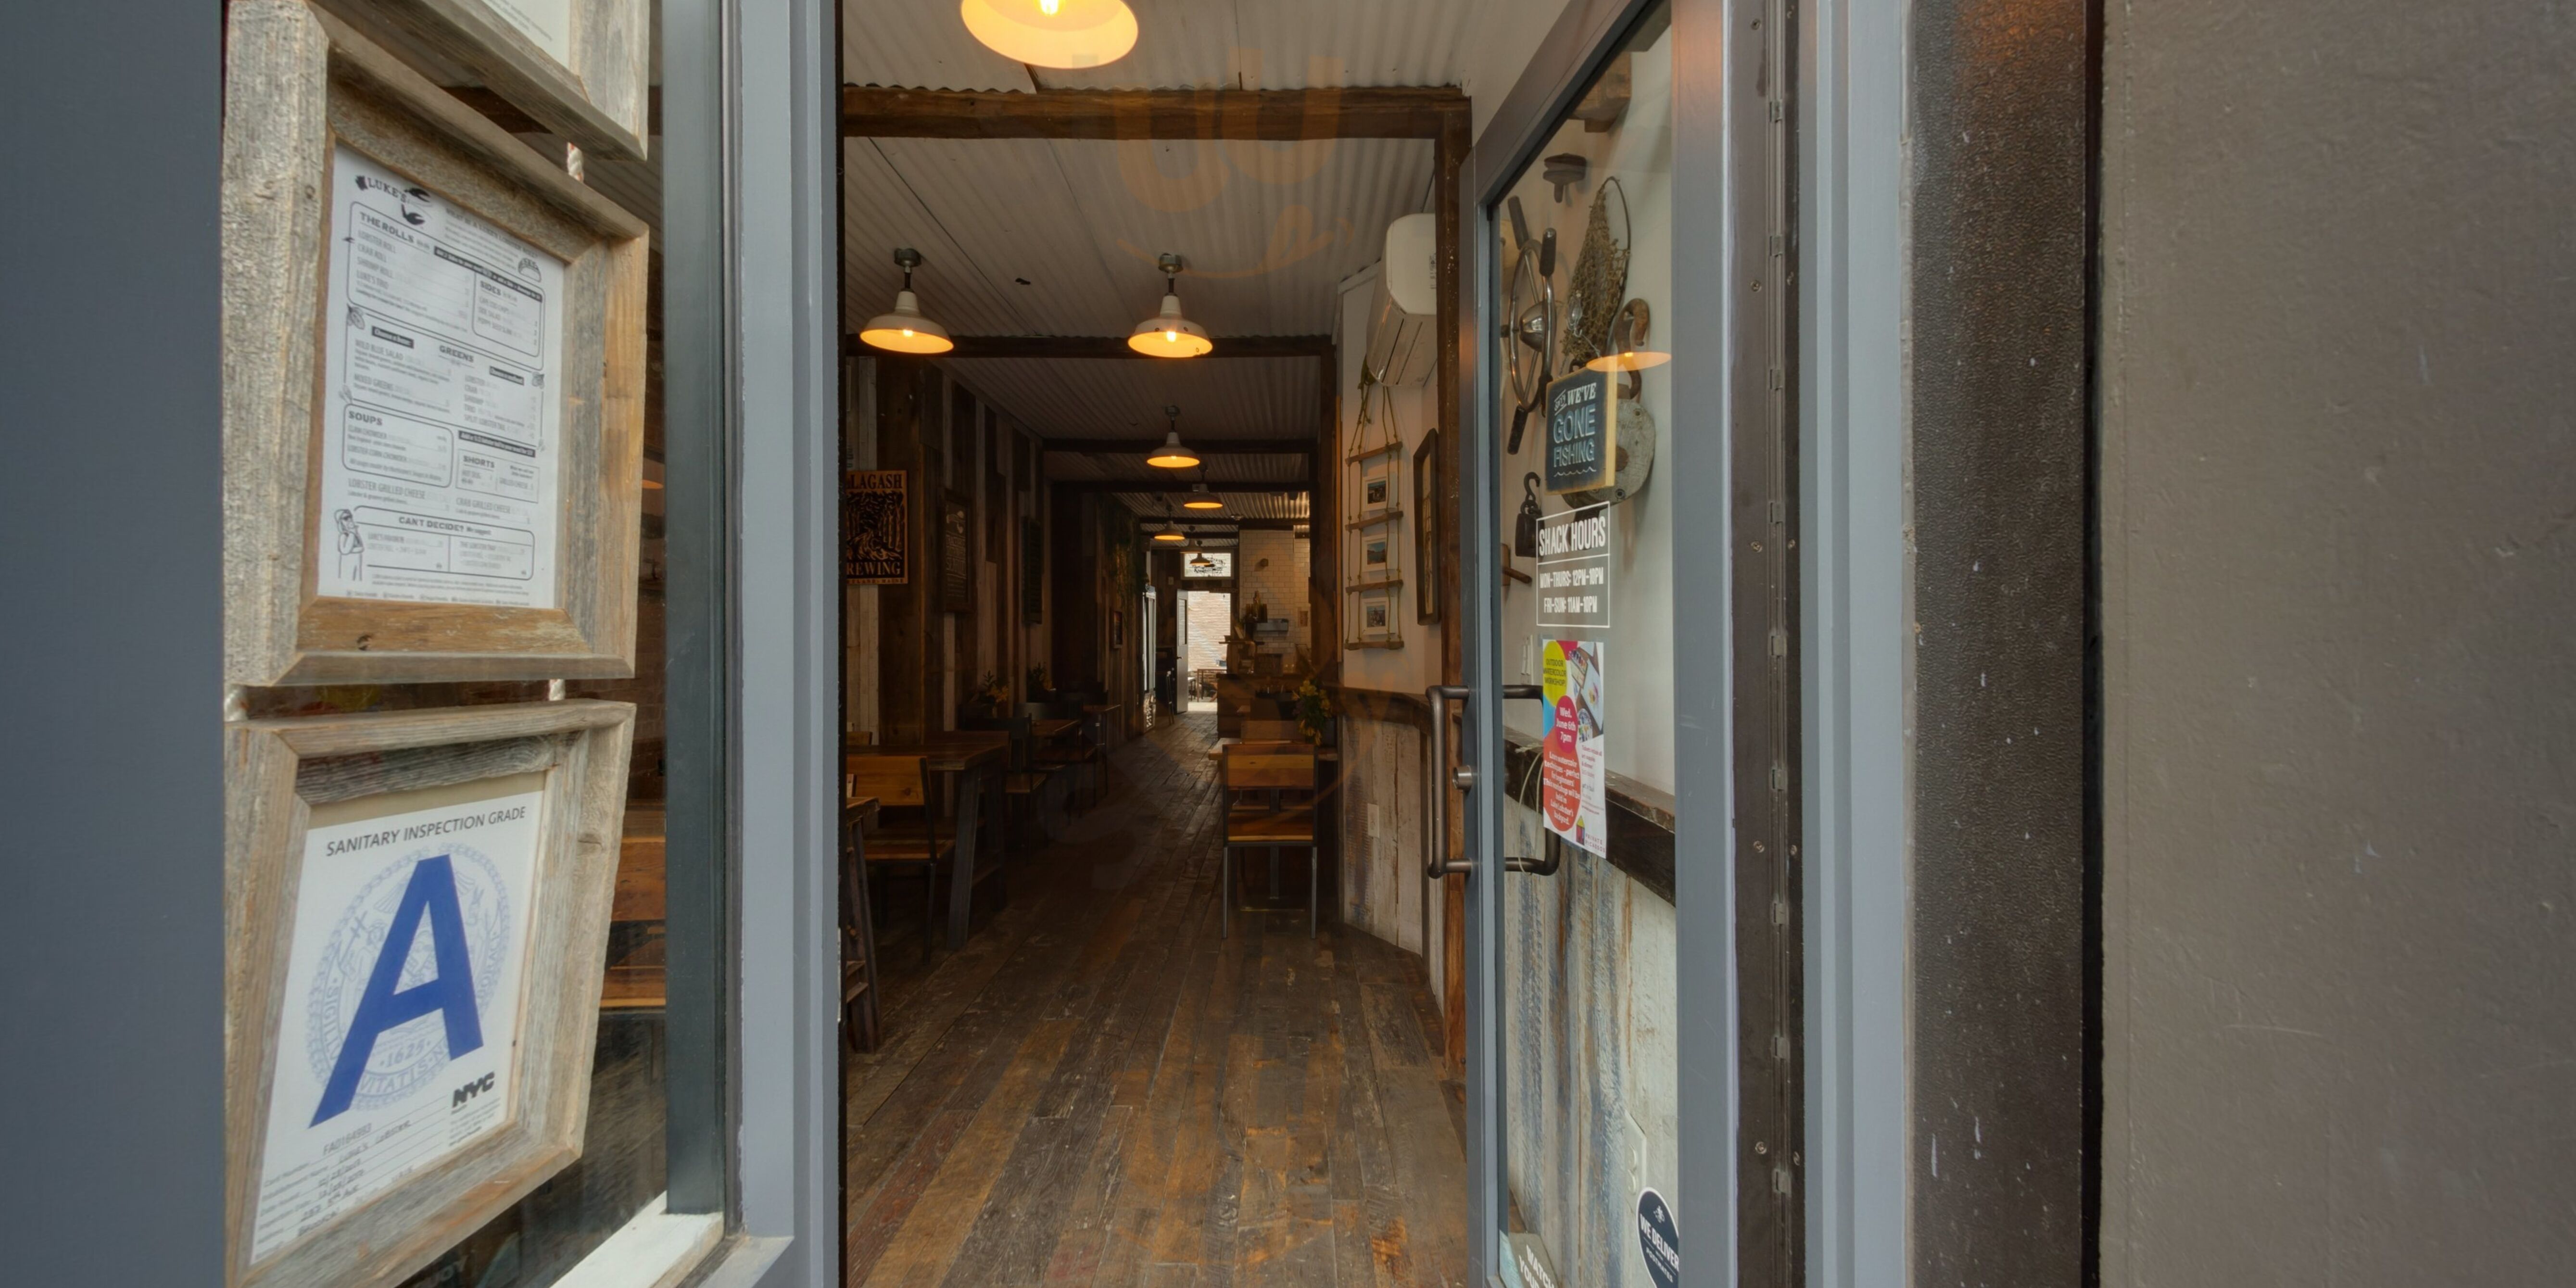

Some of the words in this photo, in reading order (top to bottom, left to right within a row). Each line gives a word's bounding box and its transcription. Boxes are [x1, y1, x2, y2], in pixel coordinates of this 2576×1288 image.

[367, 177, 407, 203] LUKE'S
[359, 211, 380, 228] THE
[382, 222, 414, 244] ROLLS
[480, 280, 501, 296] SIDES
[439, 344, 473, 363] GREENS
[1567, 382, 1597, 406] WE'VE
[348, 410, 383, 426] SOUPS
[1553, 403, 1596, 444] GONE
[463, 455, 494, 468] SHORTS
[1553, 438, 1595, 468] FISHING
[348, 477, 377, 491] LOBSTER
[378, 482, 403, 496] GRILLED
[404, 487, 425, 500] CHEESE
[846, 474, 903, 490] LAGASH
[455, 496, 471, 507] CRAB
[399, 516, 425, 527] CAN'T
[426, 520, 464, 532] DECIDE?
[1539, 523, 1569, 556] SHACK
[1570, 516, 1606, 552] HOURS
[846, 561, 901, 576] REWING
[1540, 570, 1571, 589] MON-THURS:
[1572, 567, 1604, 587] 12PM-10PM
[1543, 597, 1566, 613] FRI-SUN:
[1567, 595, 1598, 613] 11AM-10PM
[1546, 658, 1564, 668] OUTDOOR
[1543, 668, 1567, 678] WATERCOLOR
[1559, 707, 1572, 718] Wed.
[1556, 718, 1568, 728] June
[1568, 721, 1577, 732] 6th
[1560, 731, 1572, 745] 7pm
[326, 829, 401, 857] SANITARY
[403, 813, 486, 841] INSPECTION
[488, 806, 527, 826] GRADE
[308, 854, 484, 1129] A
[386, 1040, 424, 1068] 1625
[452, 1071, 495, 1108] NYC
[1640, 1213, 1652, 1239] WE
[1652, 1227, 1679, 1272] DELIVER
